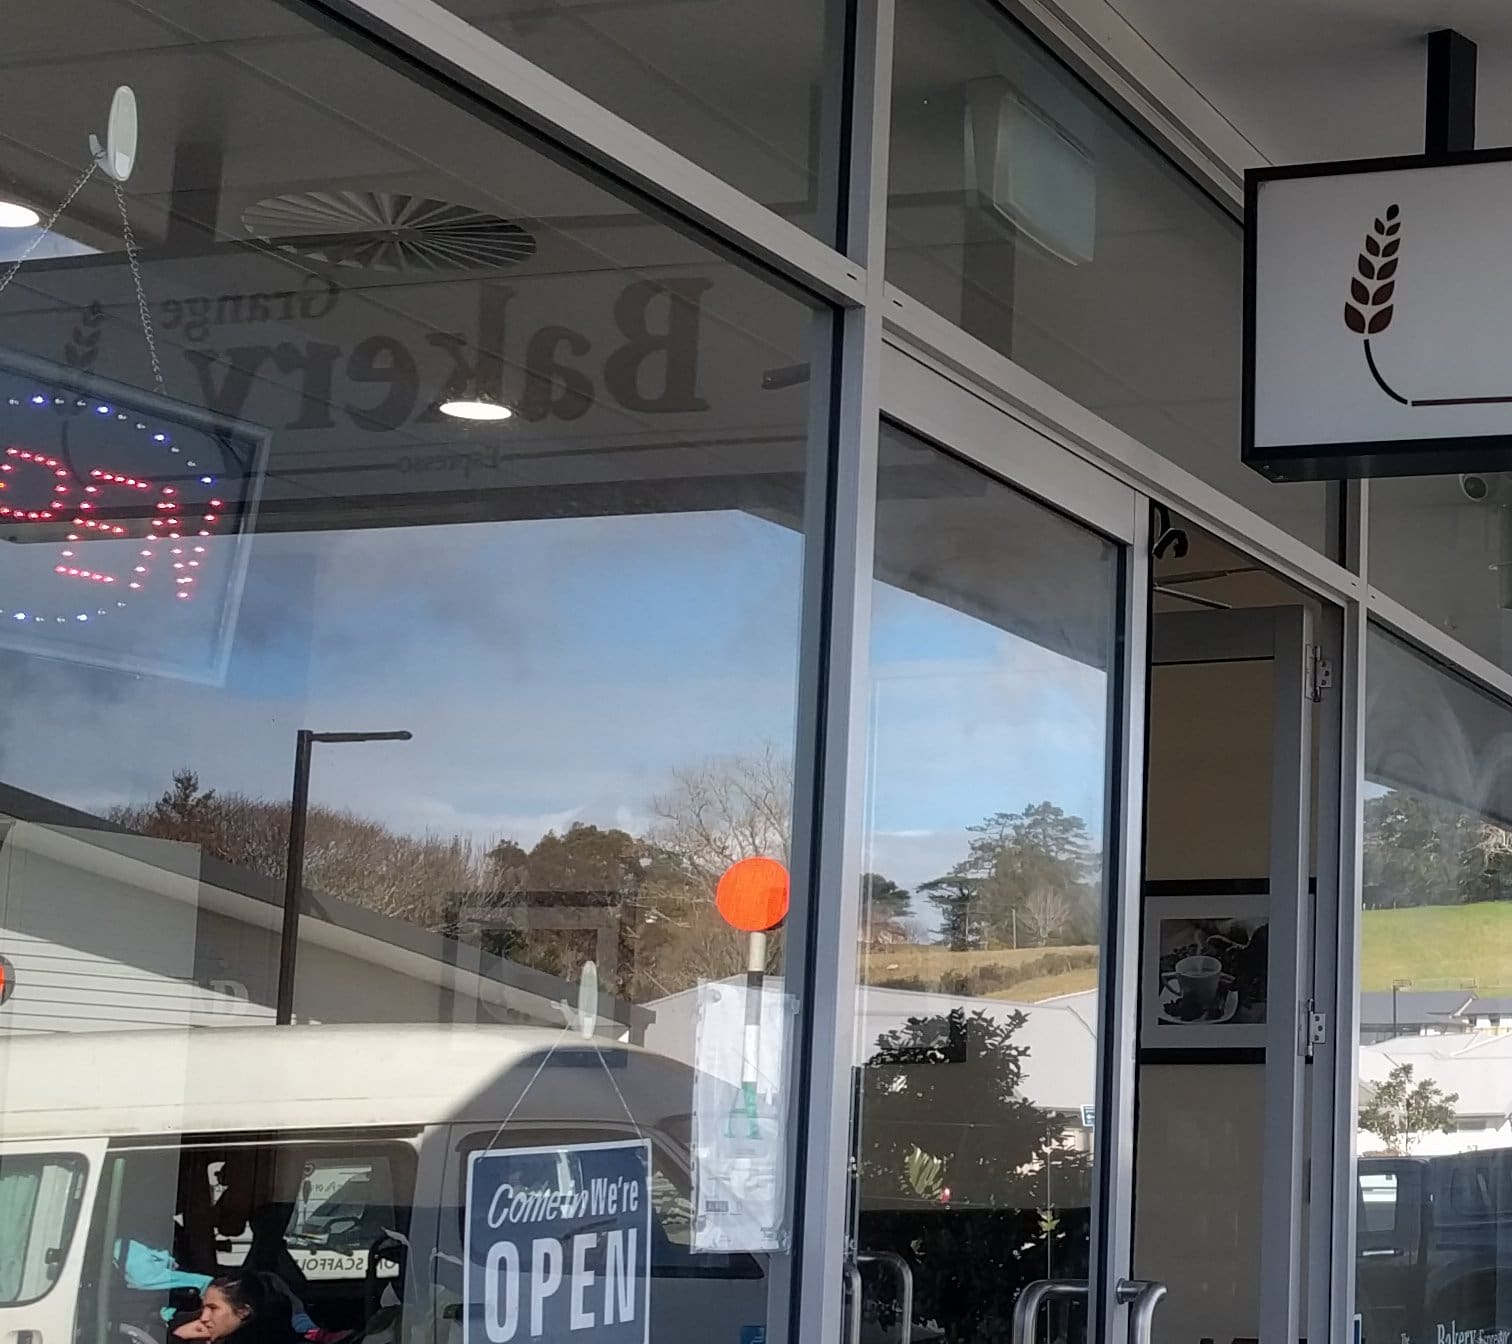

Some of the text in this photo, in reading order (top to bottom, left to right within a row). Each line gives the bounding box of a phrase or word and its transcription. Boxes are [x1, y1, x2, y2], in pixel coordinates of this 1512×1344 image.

[487, 1183, 558, 1229] Come
[591, 1175, 639, 1216] We're
[484, 1227, 638, 1344] OPEN
